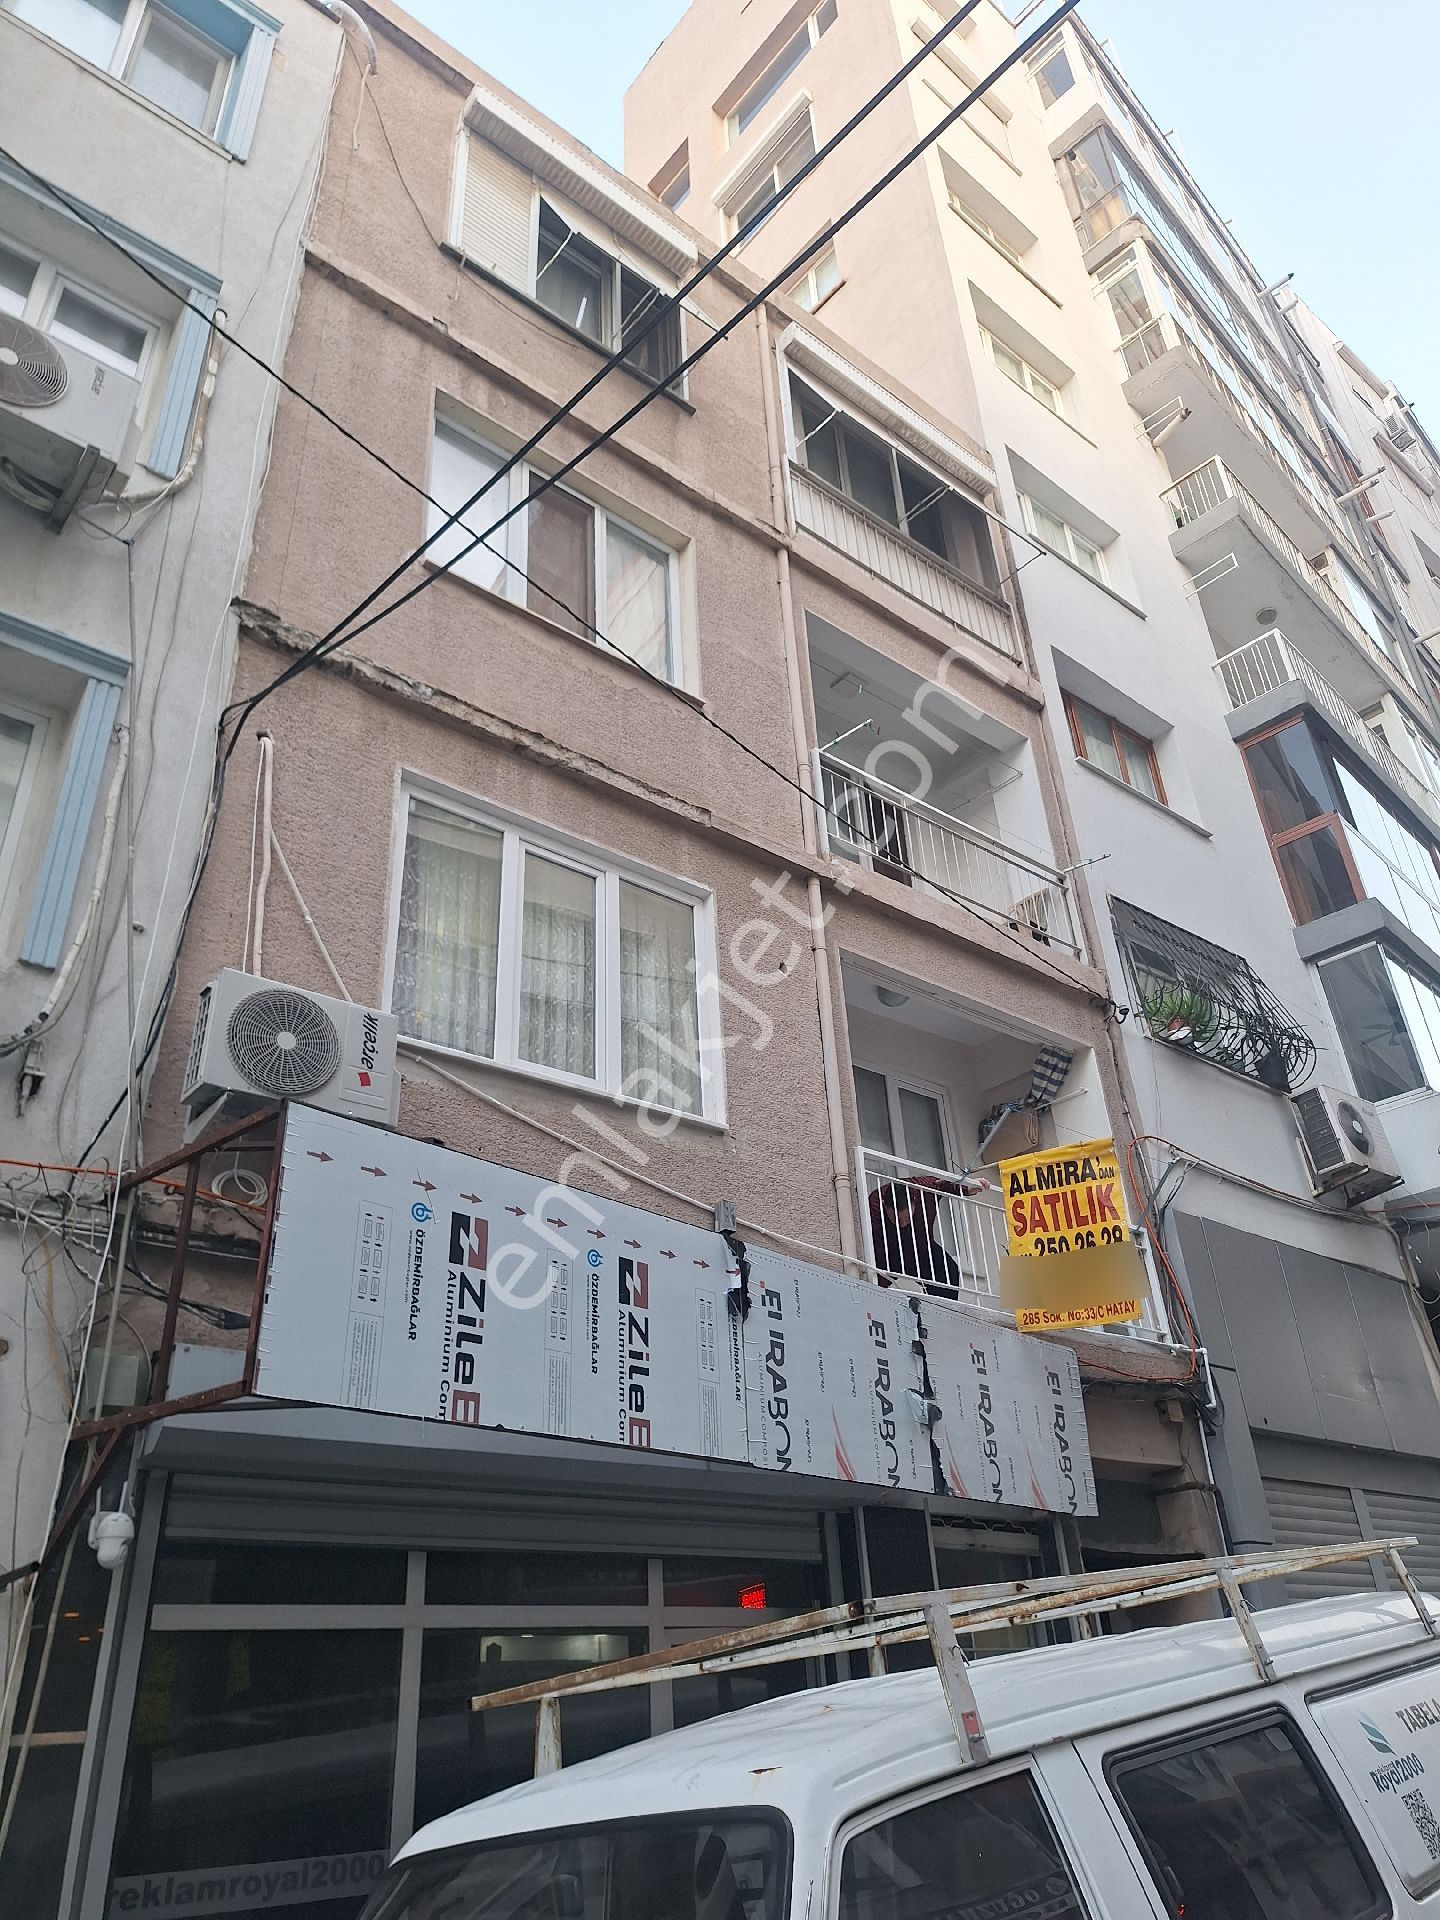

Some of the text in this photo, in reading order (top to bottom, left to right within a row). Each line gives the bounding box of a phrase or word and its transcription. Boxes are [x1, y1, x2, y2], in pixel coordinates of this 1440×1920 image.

[360, 1012, 379, 1070] arçelik
[1011, 1183, 1121, 1237] SATILIK
[408, 1228, 426, 1341] ÖZDEMİRBAĞLAR
[441, 1269, 457, 1373] Aluminium
[1022, 1311, 1041, 1326] 285
[1106, 1300, 1136, 1315] HATAY
[591, 1273, 600, 1375] ÖZDEMİRBAĞLAR
[618, 1309, 627, 1403] Aluminium
[1369, 1753, 1424, 1794] Royal2000
